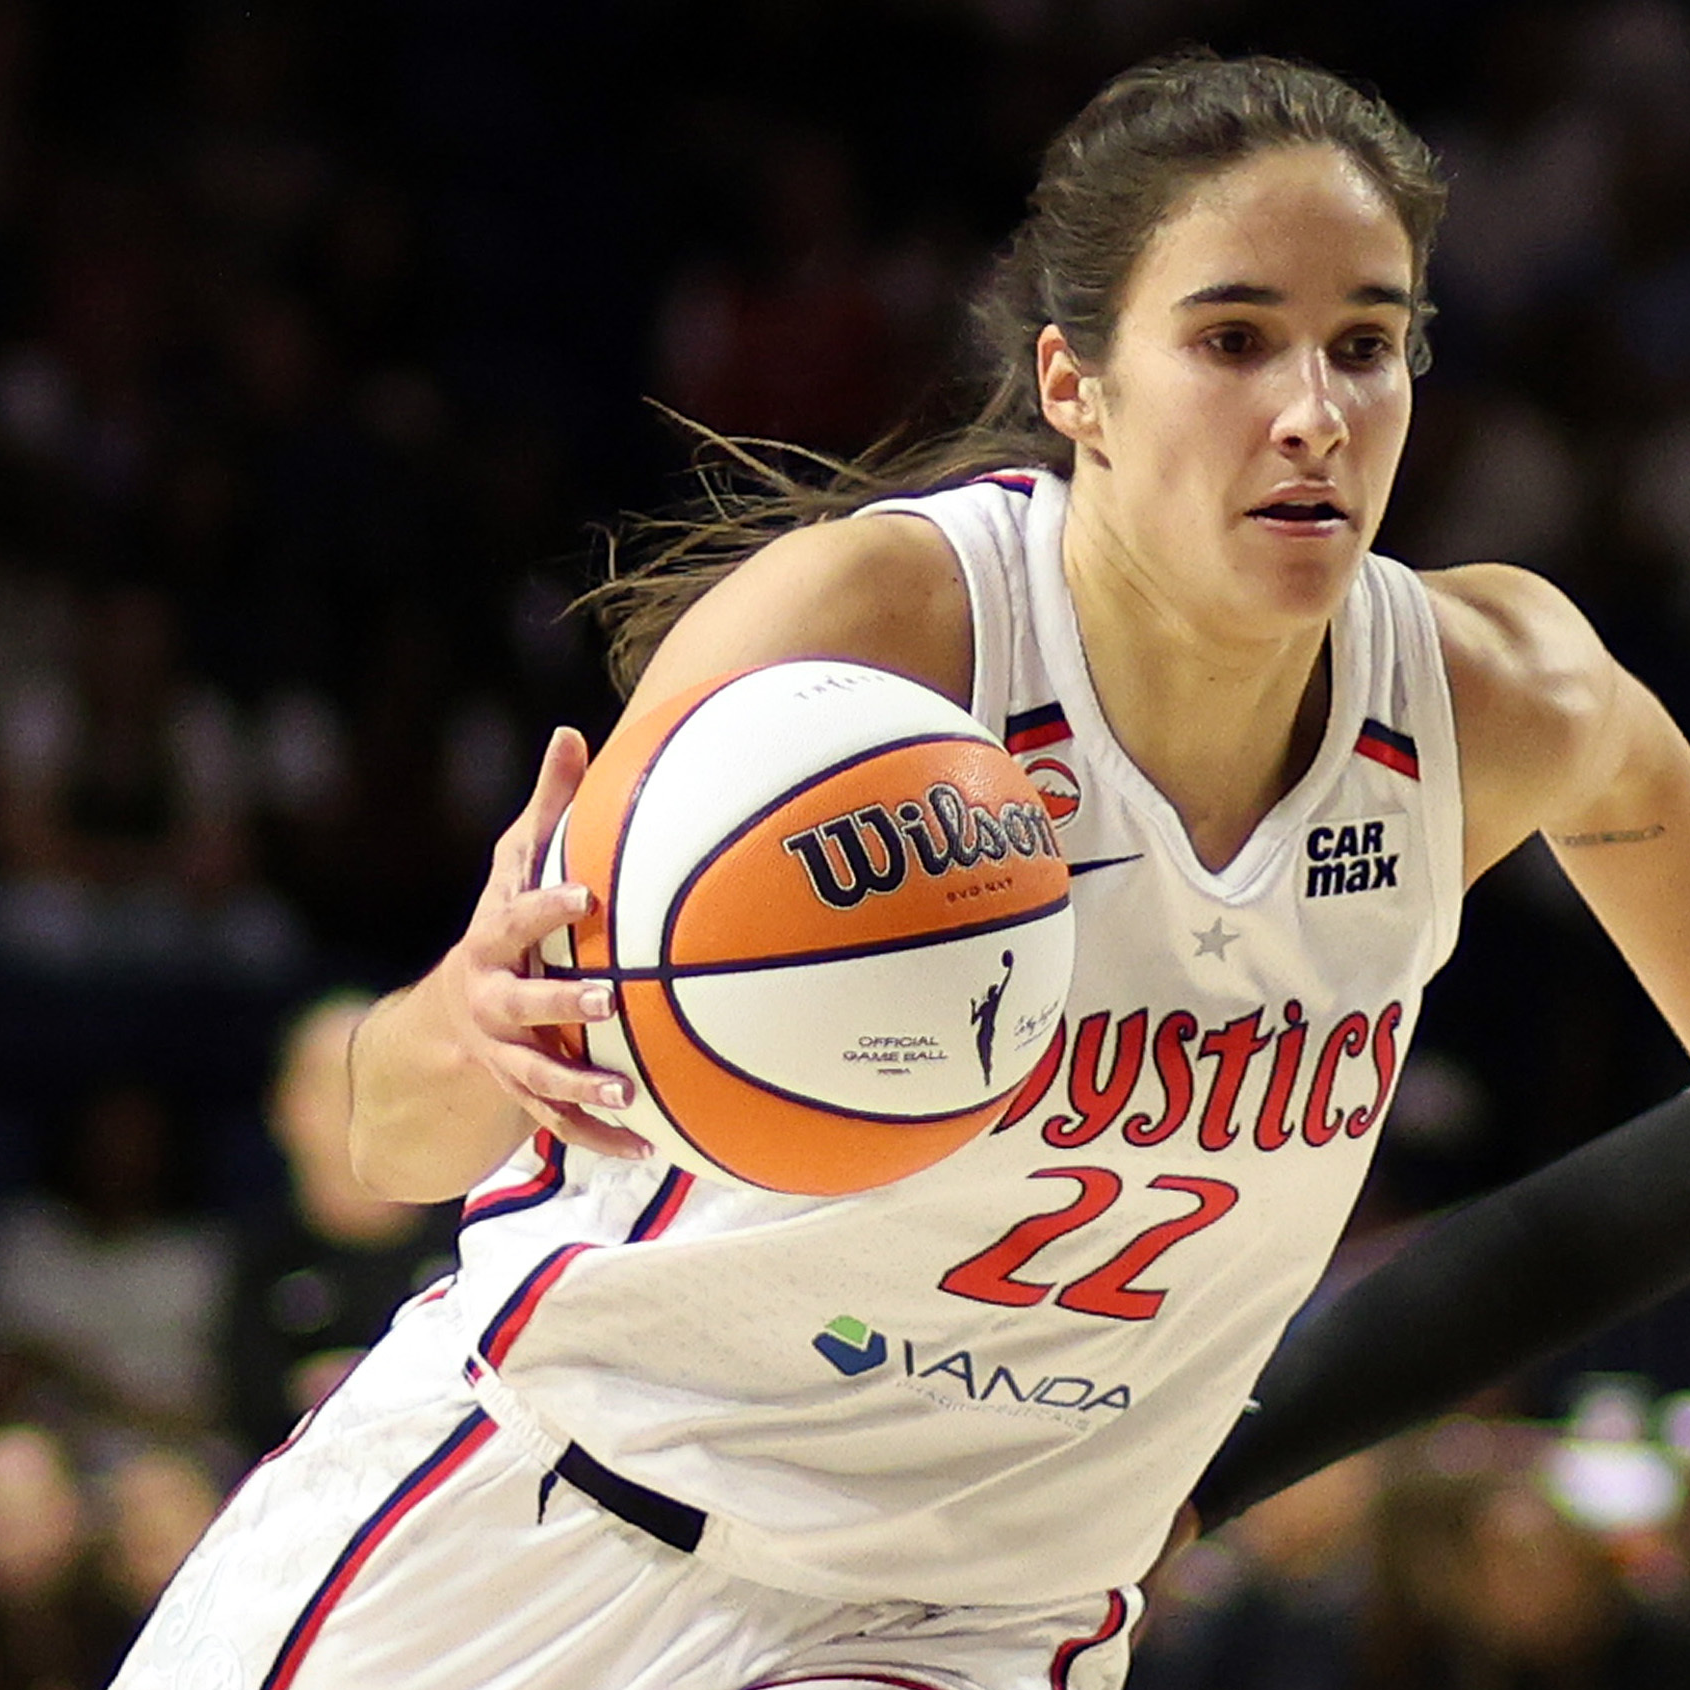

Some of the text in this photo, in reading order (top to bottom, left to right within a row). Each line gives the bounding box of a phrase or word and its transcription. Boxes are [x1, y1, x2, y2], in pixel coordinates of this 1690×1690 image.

[782, 782, 1061, 910] Wilson
[1307, 821, 1384, 861] CAR
[1305, 853, 1400, 898] max
[842, 1050, 948, 1062] GAME BALL
[858, 1036, 939, 1047] OFFICIAL
[937, 1166, 1238, 1320] 22
